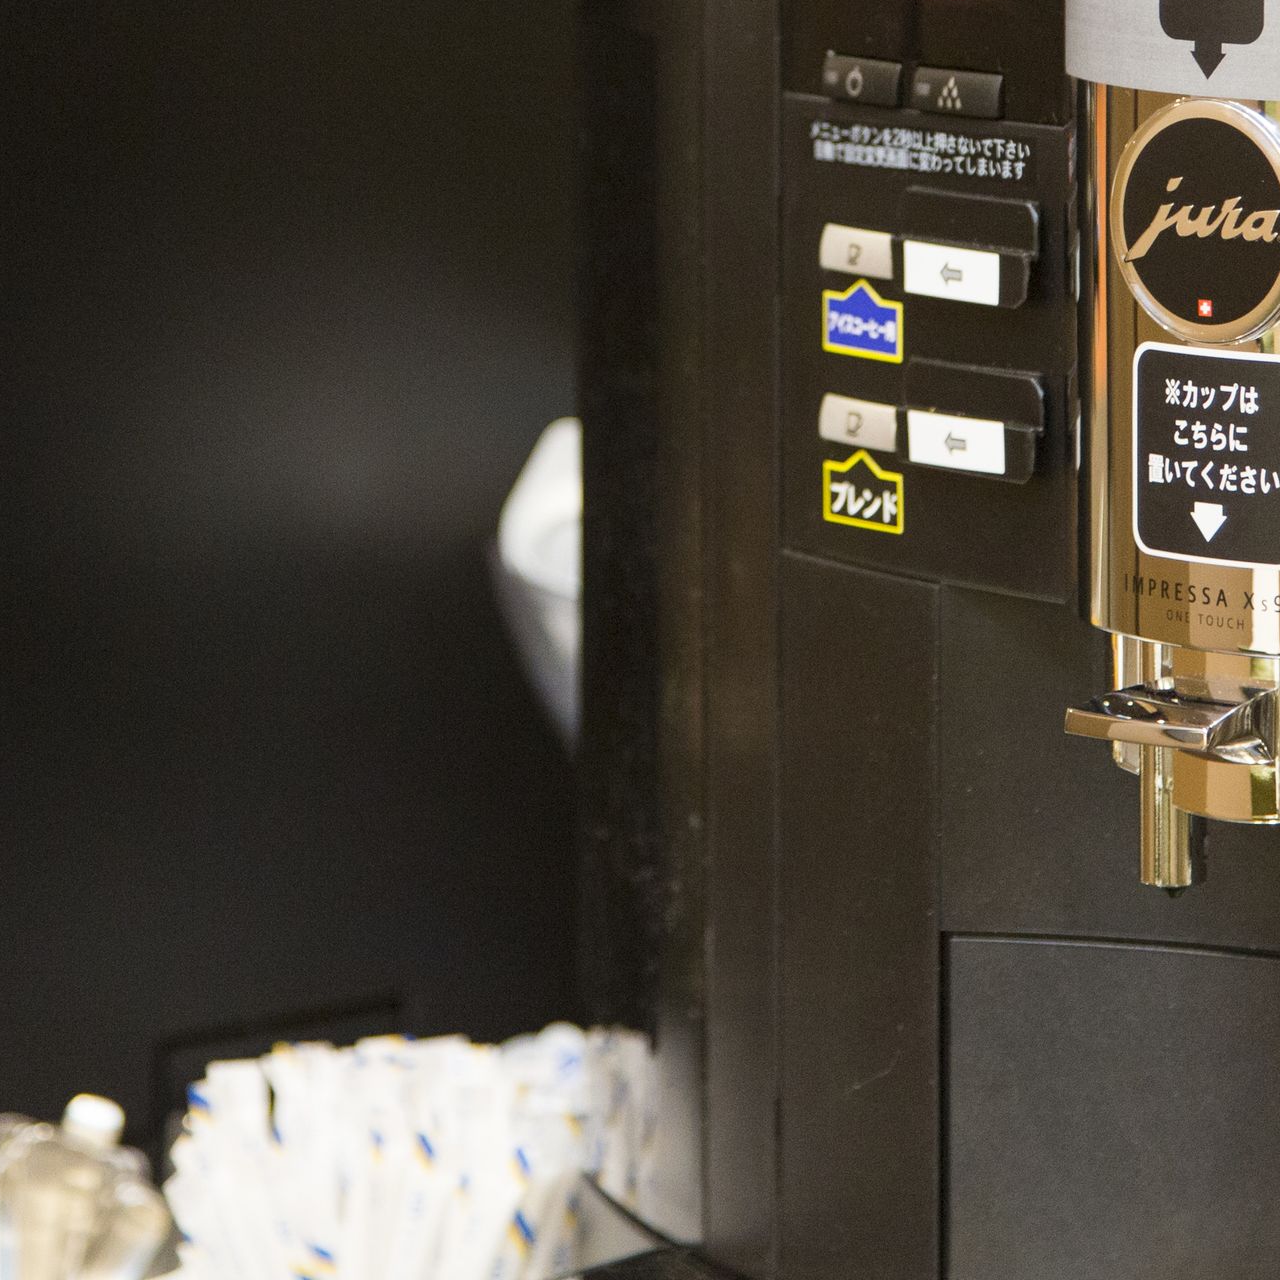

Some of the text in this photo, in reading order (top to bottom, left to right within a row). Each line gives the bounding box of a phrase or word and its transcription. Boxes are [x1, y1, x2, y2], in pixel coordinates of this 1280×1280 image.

[1124, 176, 1280, 262] jura
[1165, 378, 1259, 414] ※カップは
[1173, 420, 1248, 451] こちらに
[1148, 453, 1280, 495] 置いてください
[829, 481, 898, 523] ブレンド
[1124, 573, 1228, 608] IMPRESSA
[1166, 609, 1245, 630] ONE TOUCH
